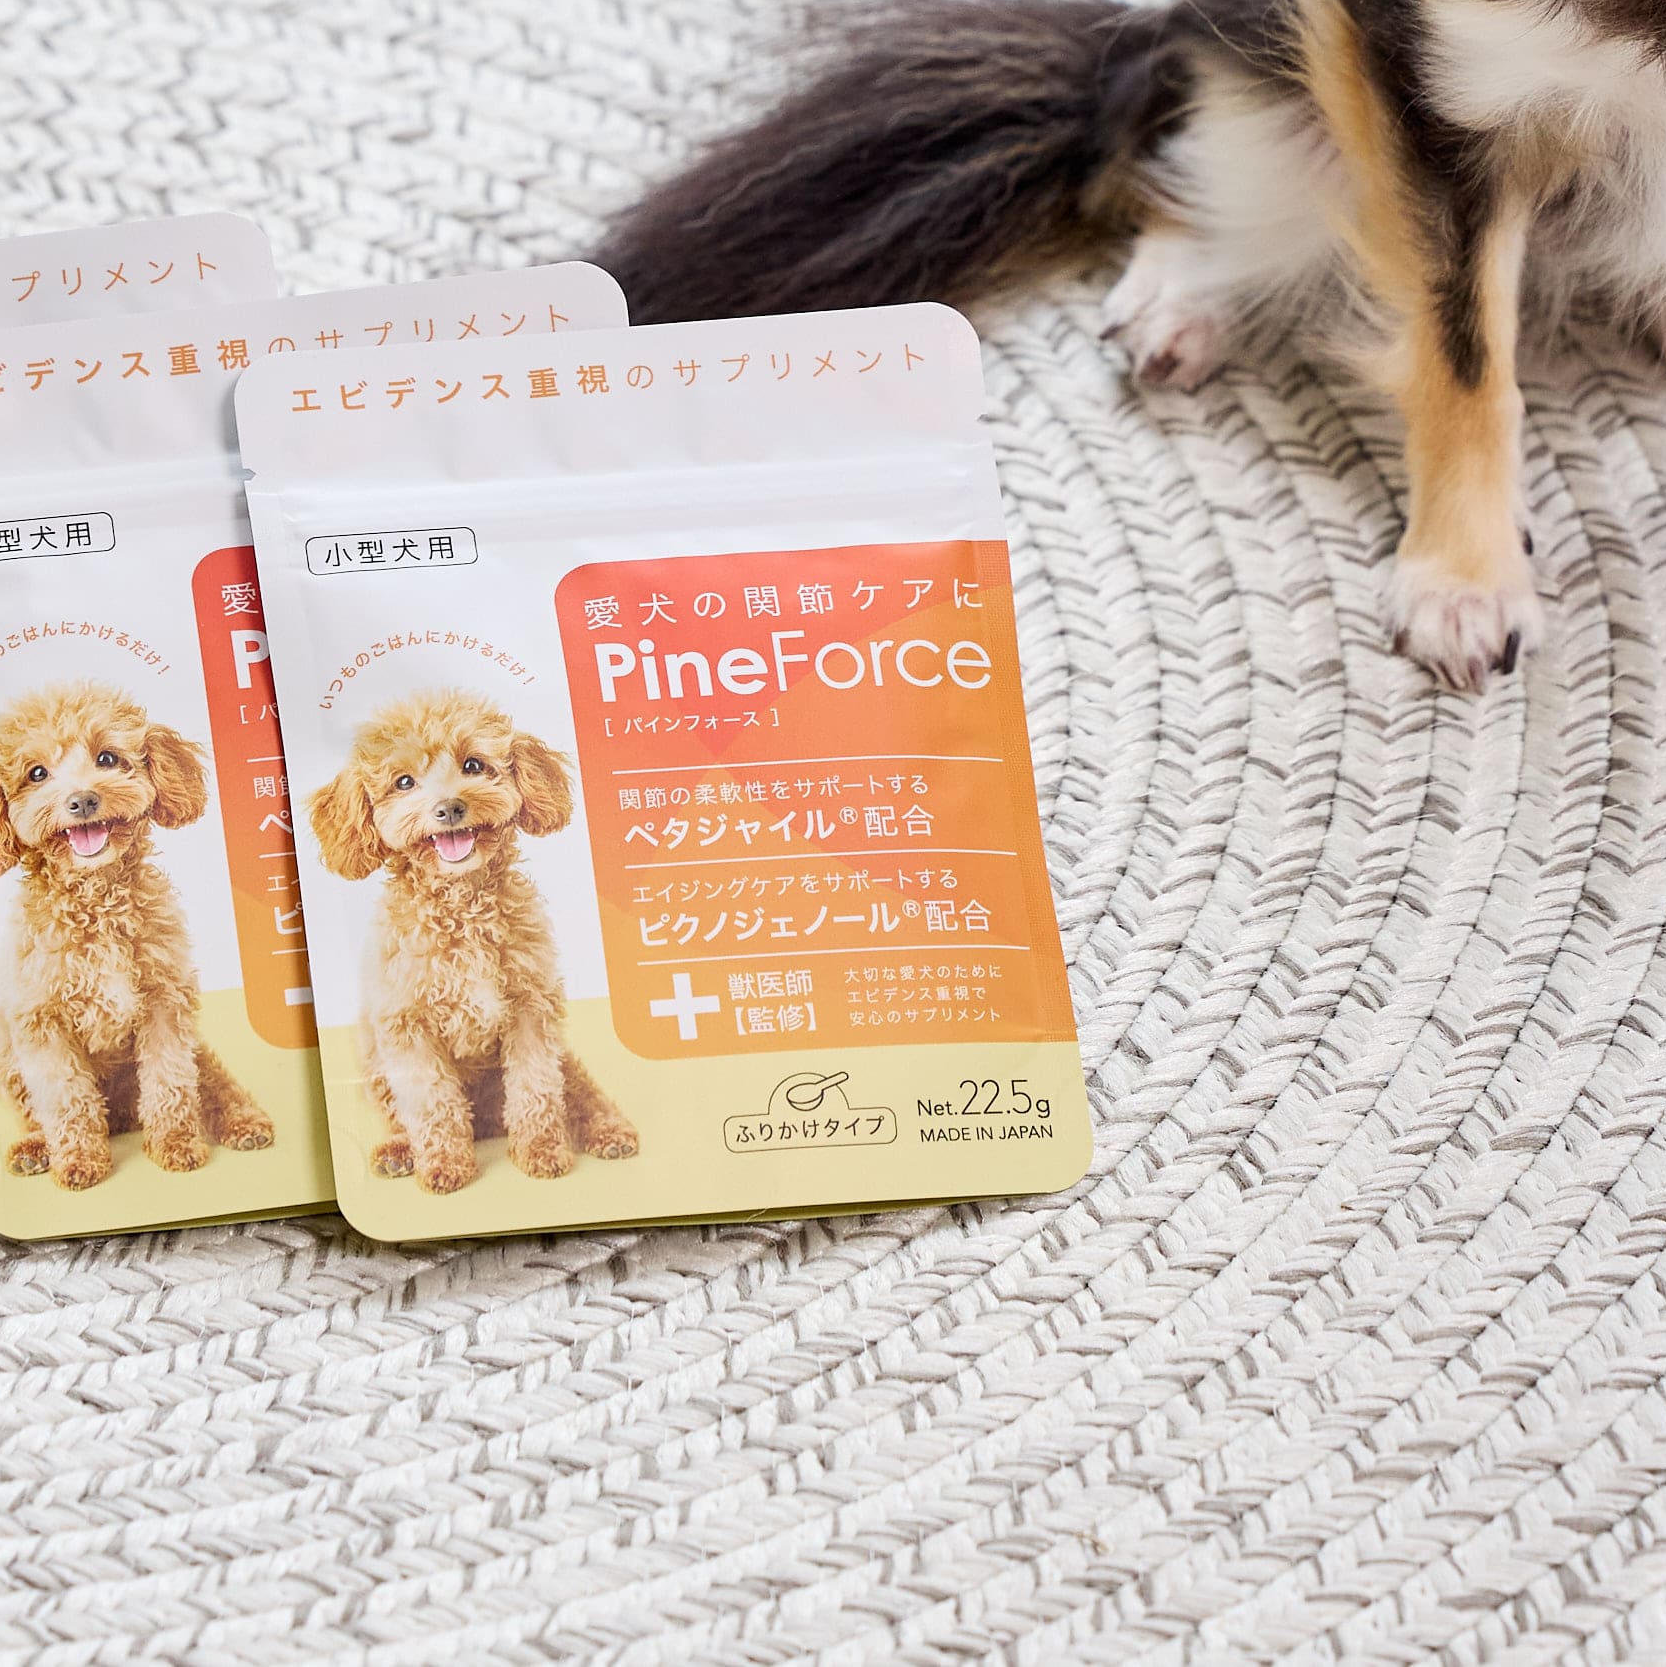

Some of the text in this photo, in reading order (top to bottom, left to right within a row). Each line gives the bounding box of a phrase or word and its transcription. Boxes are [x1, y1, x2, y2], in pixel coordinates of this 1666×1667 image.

[290, 342, 929, 414] エビデンス重視のサプリメント
[323, 535, 457, 567] 小型犬用
[583, 577, 984, 632] 愛犬の関節ケアに
[594, 630, 993, 704] PineForce
[618, 774, 930, 811] 関節の柔軟性をサポートする
[632, 868, 959, 904] エイジングケアをサポートする
[727, 968, 814, 1001] 獣医師
[844, 964, 1003, 984] 大切な愛犬のために
[847, 986, 987, 1004] エビデンス重視で
[734, 1002, 818, 1036] 【監修】
[849, 1007, 1002, 1027] 安心のサプリメント
[736, 1115, 886, 1143] ふりかけタイプ
[920, 1124, 1054, 1143] MADE IN JAPAN
